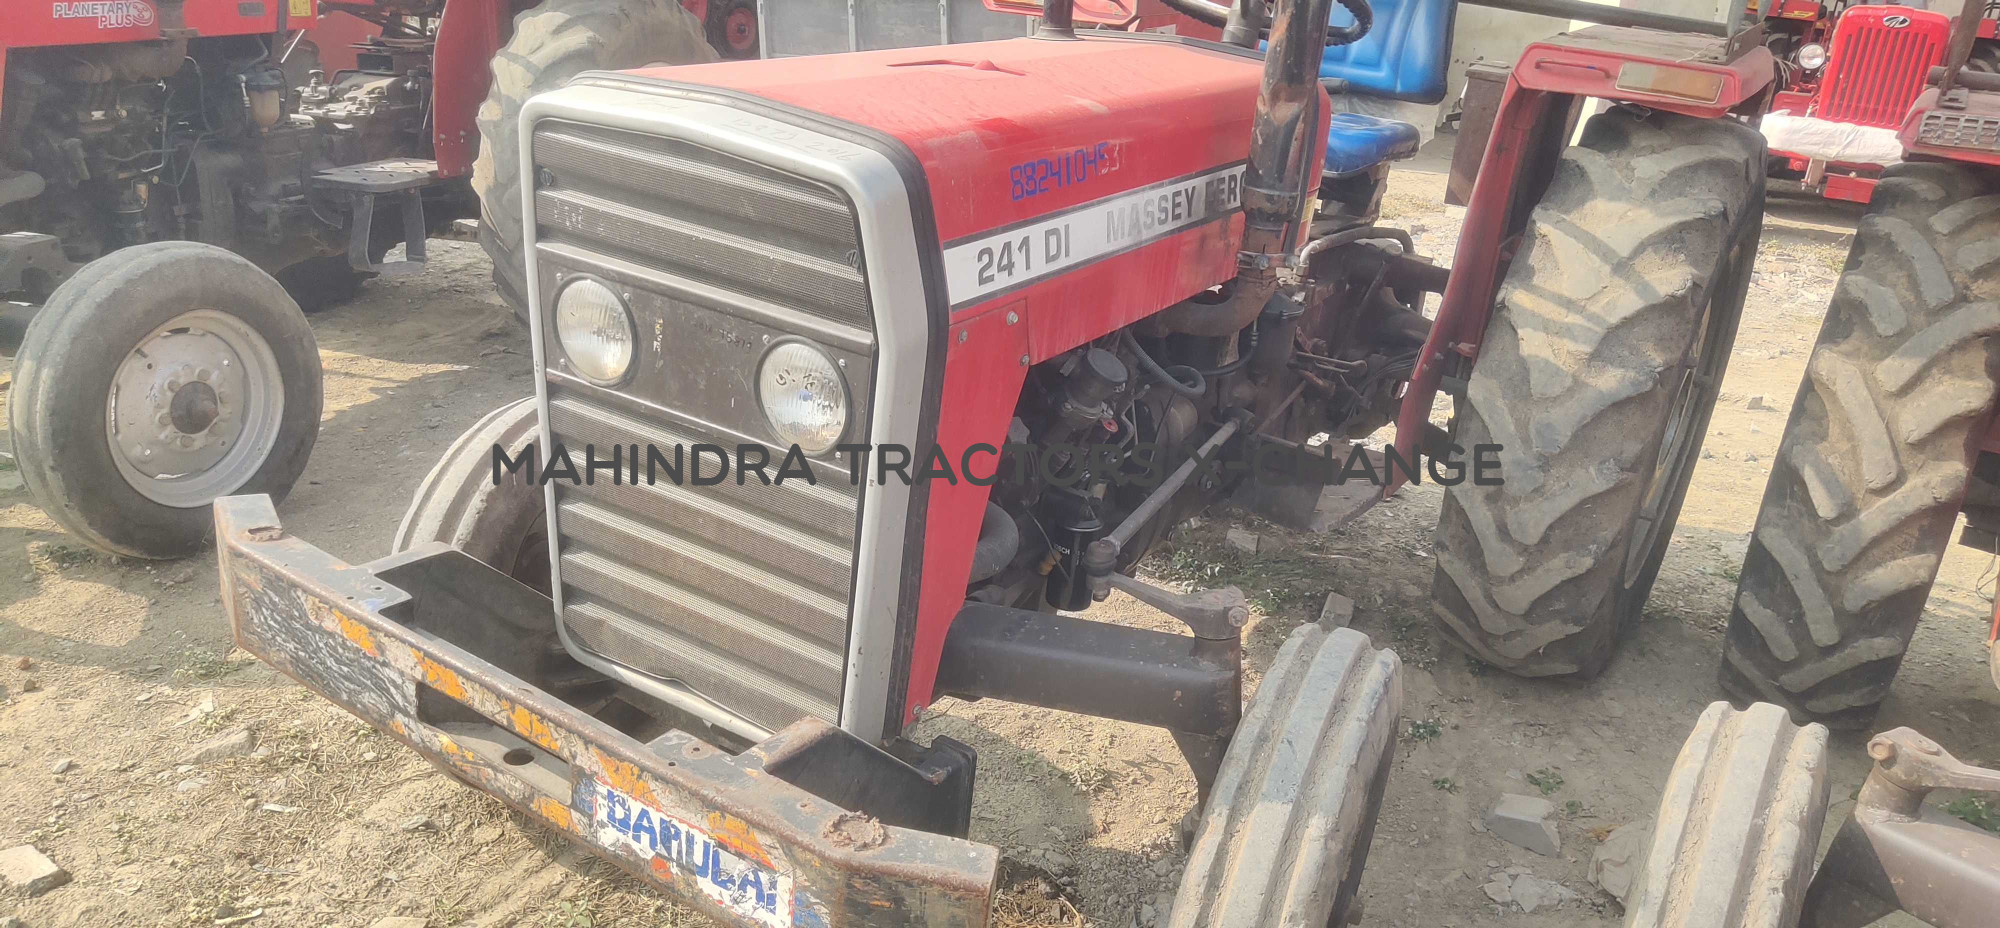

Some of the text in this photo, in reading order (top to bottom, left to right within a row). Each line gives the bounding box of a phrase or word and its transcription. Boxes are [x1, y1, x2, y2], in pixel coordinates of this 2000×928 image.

[53, 2, 132, 17] PLANETARY
[99, 14, 133, 28] PLUS
[976, 234, 1031, 287] 241
[1044, 223, 1070, 265] DI
[1106, 185, 1197, 244] MASSEY
